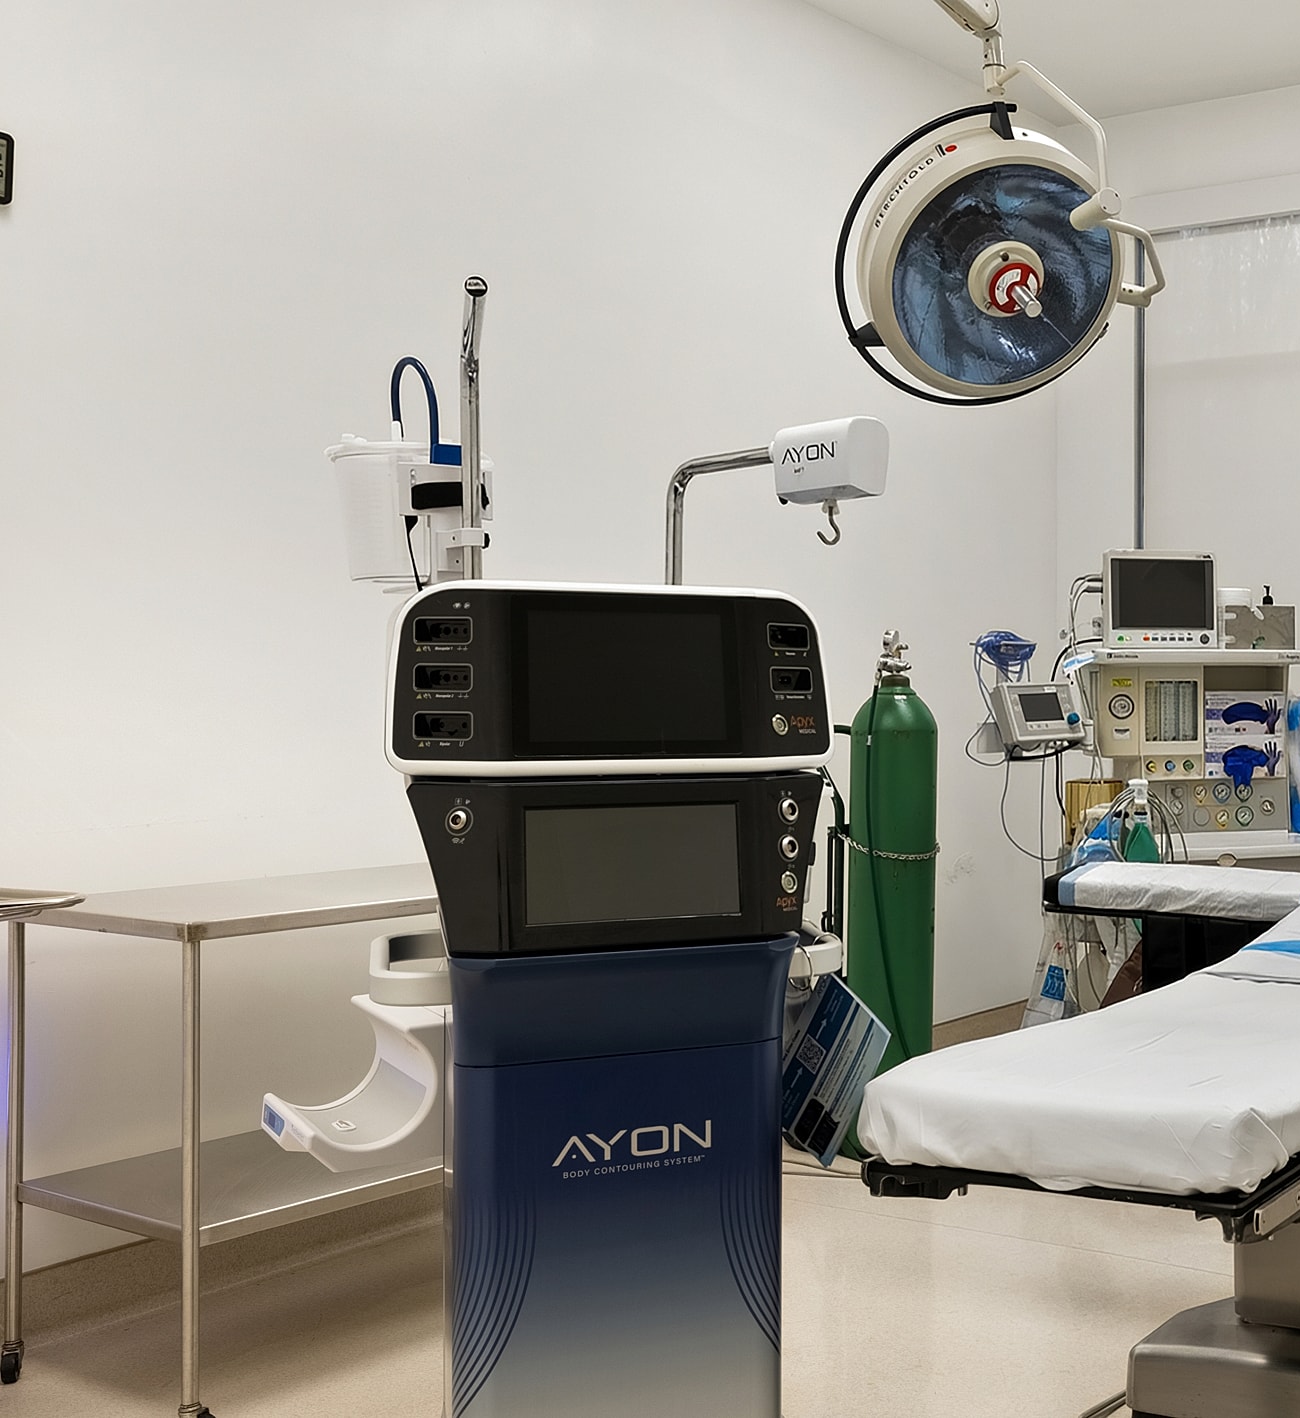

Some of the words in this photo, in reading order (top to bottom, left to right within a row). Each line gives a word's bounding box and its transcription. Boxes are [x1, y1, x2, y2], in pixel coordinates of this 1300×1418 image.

[781, 441, 836, 465] AYON
[552, 1119, 712, 1168] AYON
[563, 1169, 590, 1179] BODY
[594, 1160, 660, 1176] CONTOURING
